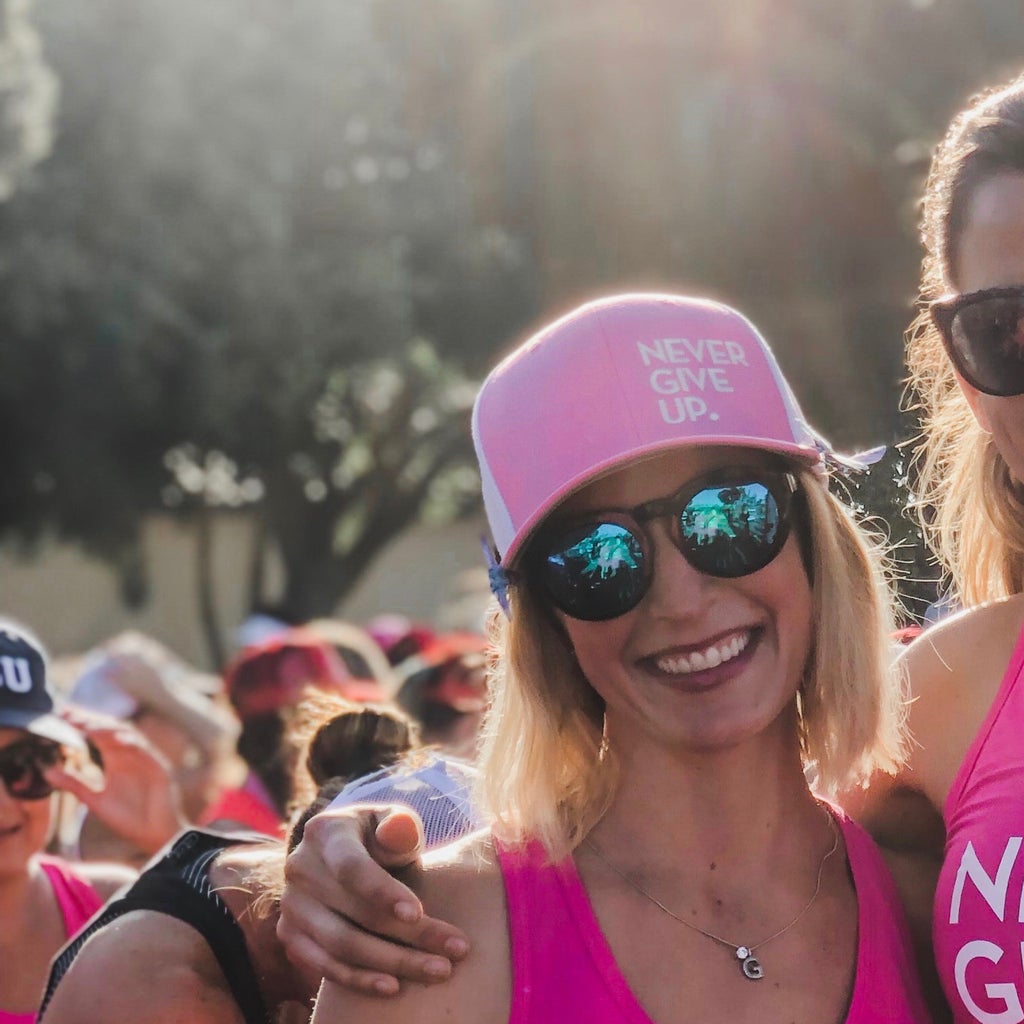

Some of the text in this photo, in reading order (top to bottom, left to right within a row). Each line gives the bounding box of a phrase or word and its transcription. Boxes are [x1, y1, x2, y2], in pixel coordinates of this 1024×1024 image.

[636, 337, 748, 367] NEVER
[650, 367, 734, 395] GIVE
[658, 397, 720, 425] UP.
[0, 656, 33, 693] U
